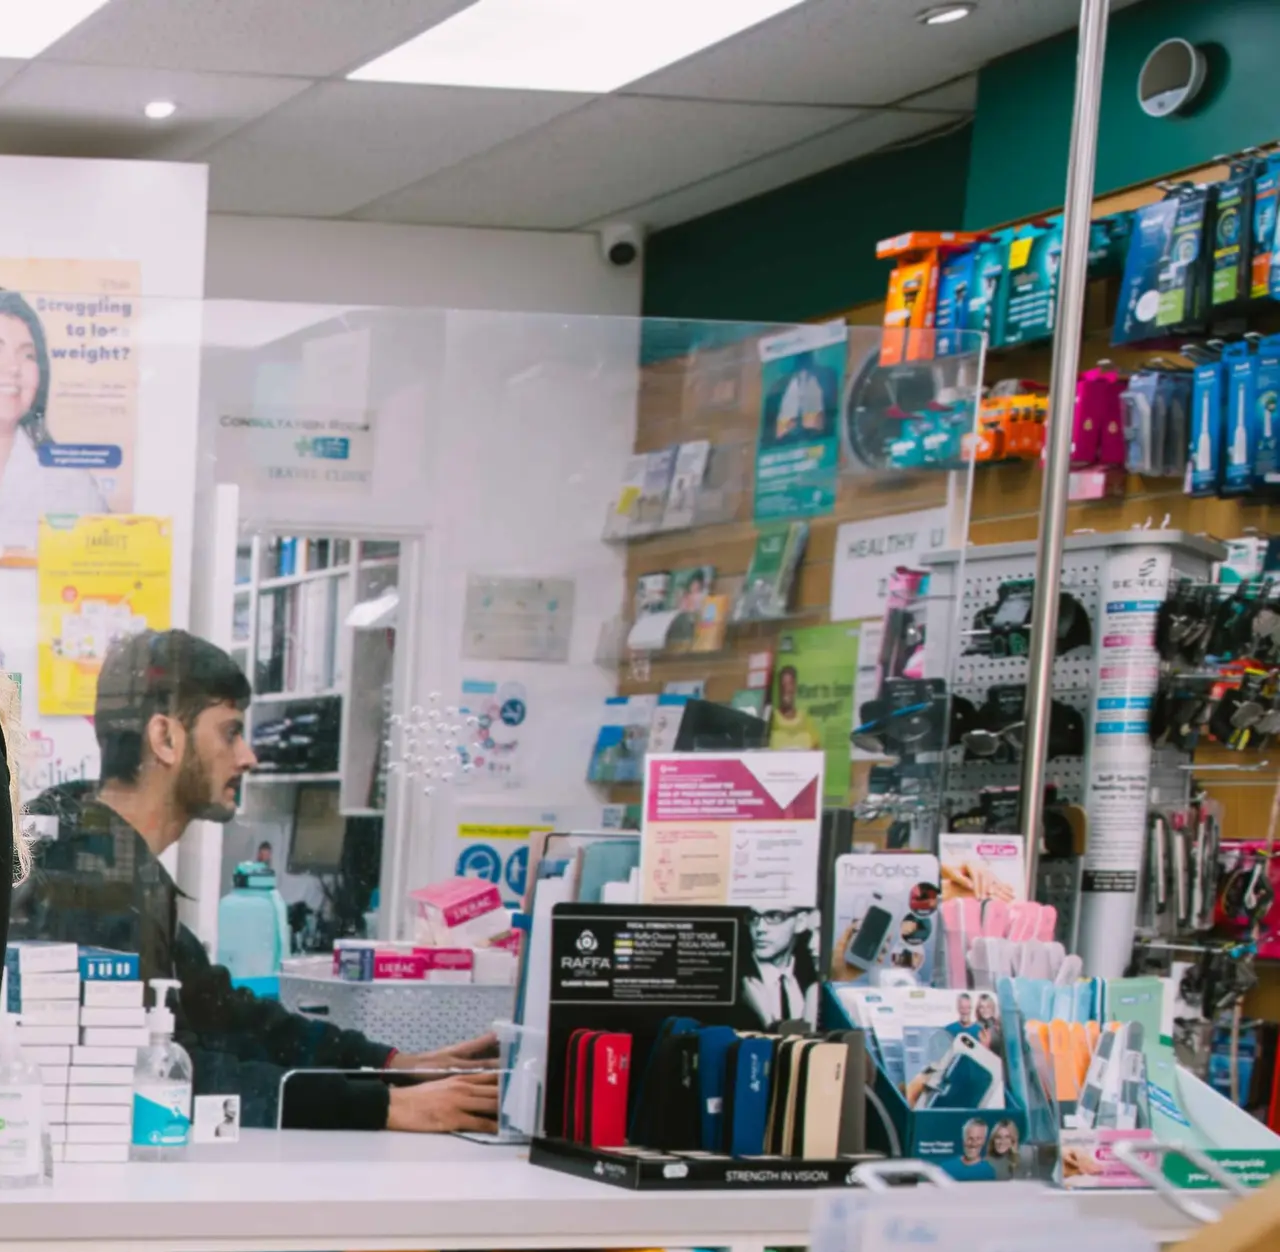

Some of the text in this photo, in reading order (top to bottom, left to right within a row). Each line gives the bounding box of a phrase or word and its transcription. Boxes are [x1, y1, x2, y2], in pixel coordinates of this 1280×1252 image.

[37, 297, 132, 317] Struggling
[65, 323, 86, 338] to
[50, 347, 131, 364] weight?
[847, 532, 918, 558] HEALTHY
[842, 861, 920, 879] ThinOptics
[560, 956, 611, 970] RAFFA
[725, 1169, 830, 1183] STRENGTH IN VISION
